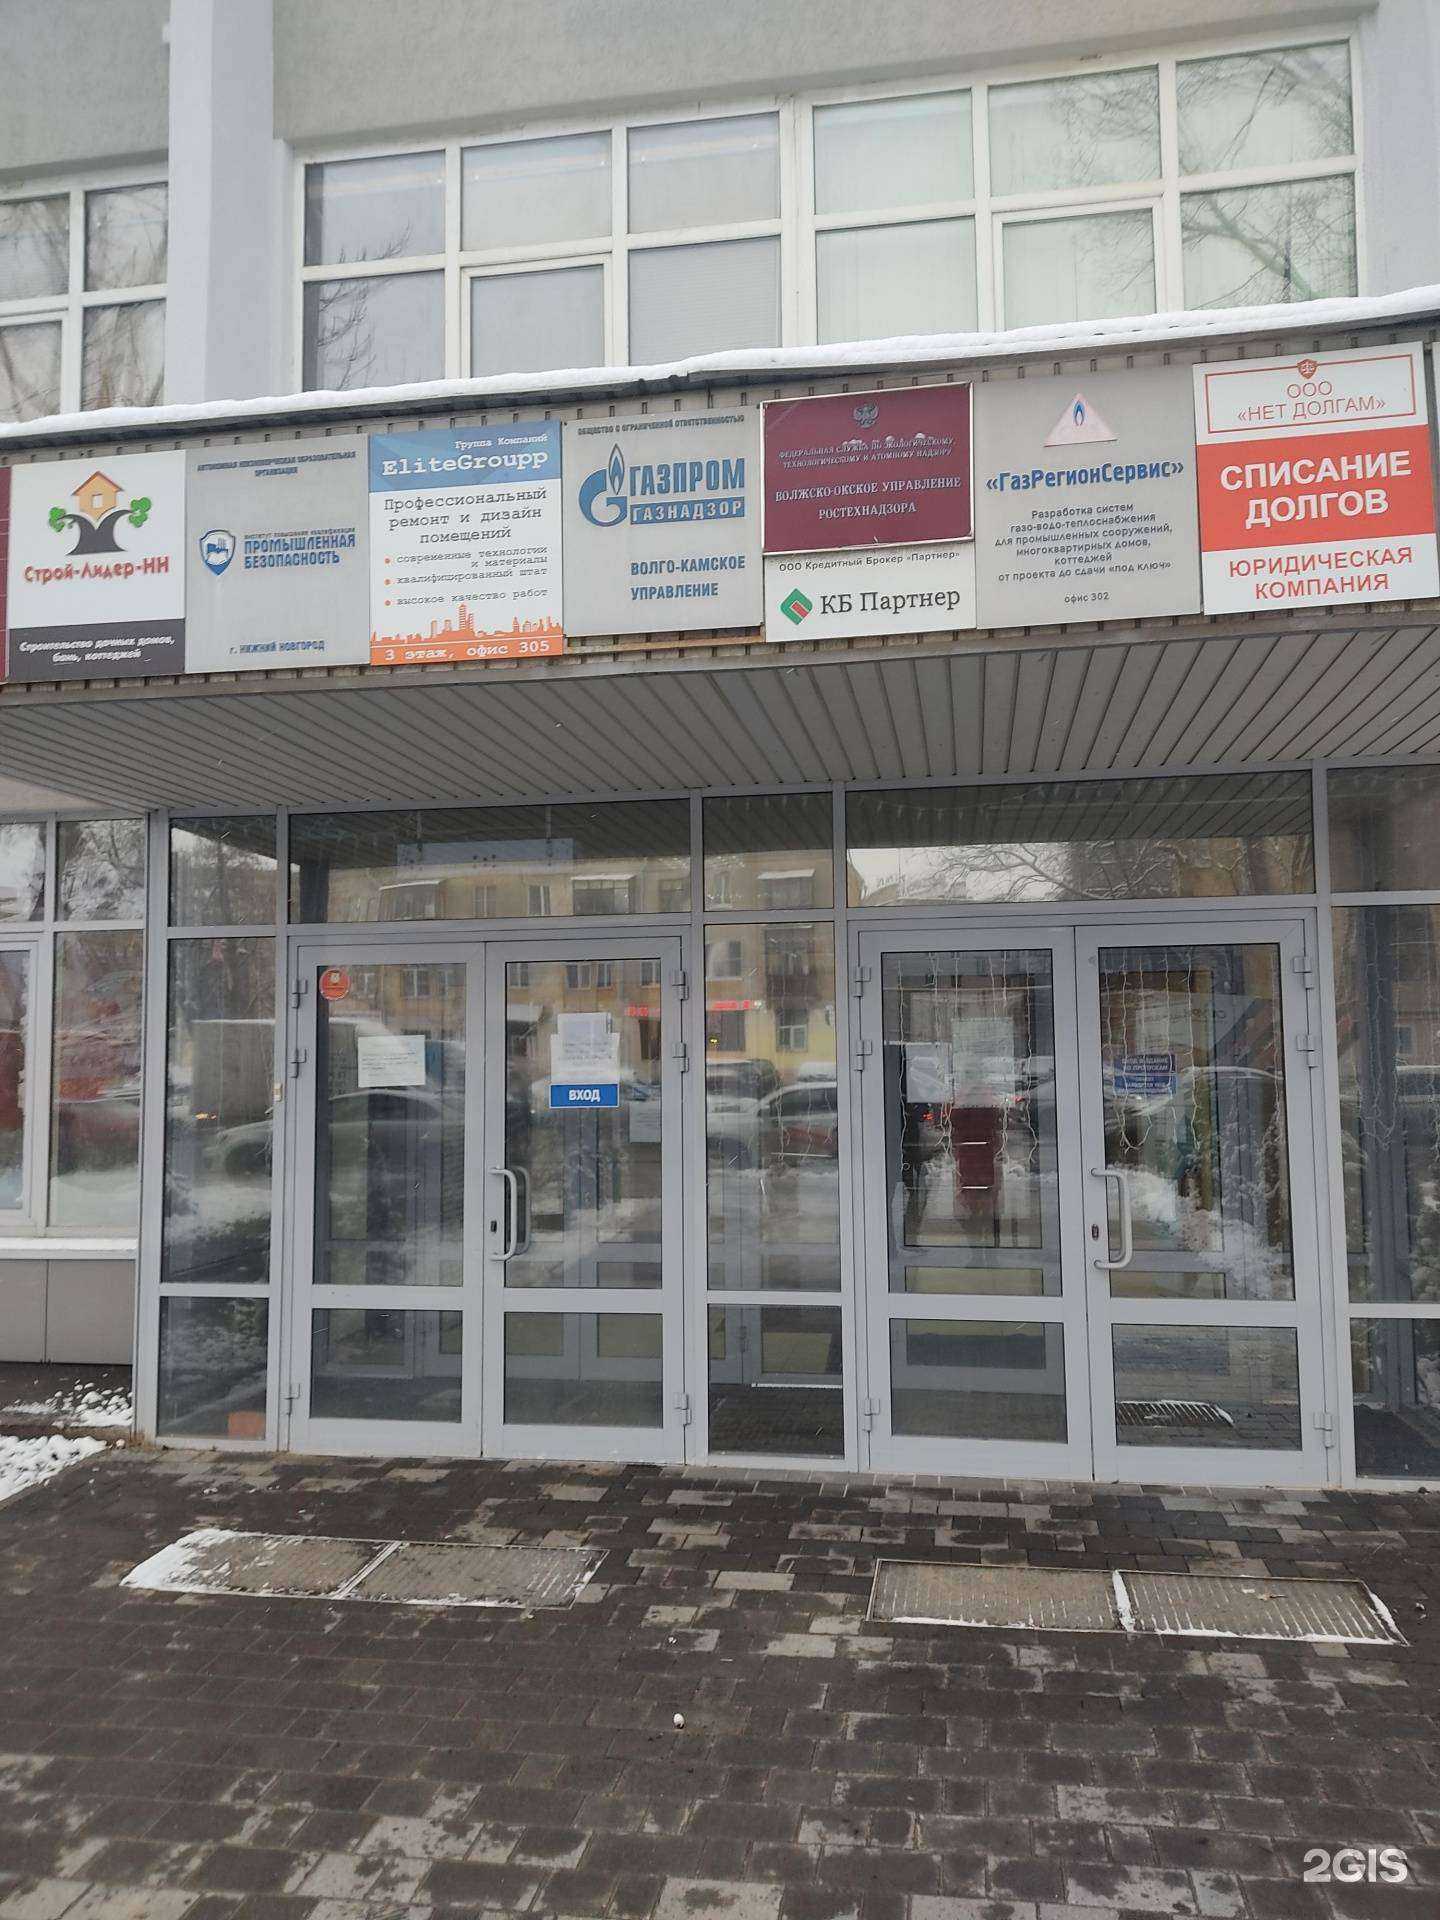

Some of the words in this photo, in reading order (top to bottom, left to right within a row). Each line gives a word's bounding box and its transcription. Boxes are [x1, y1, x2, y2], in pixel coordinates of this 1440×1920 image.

[1286, 381, 1333, 399] ООО
[1237, 403, 1287, 421] «НЕТ
[1293, 396, 1386, 420] ДОЛГАМ»
[455, 438, 492, 450] Группа
[497, 433, 548, 446] Компаний
[778, 446, 834, 460] ФЕДЕРАЛЬНАЯ
[382, 451, 548, 476] EliteGroupp
[1220, 450, 1412, 491] СПИСАНИЕ
[629, 458, 745, 496] ГАЗПРОМ
[986, 461, 1184, 491] «ГазРегионСервис»
[775, 482, 878, 501] ВОЛЖСКО-ОКСКОЕ
[882, 476, 961, 492] УПРАВЛЕНИЕ
[384, 487, 547, 512] Профессиональный
[1245, 489, 1389, 529] ДОЛГОВ
[389, 514, 449, 530] ремонт
[460, 514, 470, 523] и
[480, 507, 542, 524] дизайн
[632, 500, 742, 522] ГАЗНАДЗОР
[819, 501, 917, 519] РОСТЕХНАДЗОРА
[1031, 506, 1093, 520] Разработка
[1096, 503, 1134, 514] систем
[1010, 513, 1156, 533] газо-водо-теплоснабжения
[244, 534, 355, 554] ПРОМЫШЛЕННАЯ
[420, 527, 511, 544] помещений
[995, 538, 1013, 548] для
[1016, 531, 1099, 547] промышленных
[1102, 523, 1173, 538] сооружений,
[396, 552, 472, 565] современные
[478, 545, 547, 558] технологии
[1016, 542, 1112, 557] многоквартирных
[1115, 538, 1151, 551] домов,
[244, 551, 340, 569] БЕЗОПАСНОСТЬ
[471, 560, 478, 568] и
[485, 557, 547, 568] материалы
[631, 556, 746, 576] ВОЛГО-КАМСКОЕ
[779, 562, 802, 572] ООО
[805, 557, 863, 571] Кредитный
[866, 555, 903, 568] Брокер
[907, 551, 960, 564] «Партнер»
[1054, 553, 1112, 566] коттеджей
[1229, 547, 1412, 578] ЮРИДИЧЕСКАЯ
[24, 556, 170, 584] Строй-Лидер-НН
[520, 567, 547, 576] штат
[998, 574, 1010, 582] от
[1013, 569, 1056, 582] проекта
[1058, 568, 1071, 578] до
[1075, 566, 1105, 577] сдачи
[397, 595, 444, 605] высокое
[451, 592, 506, 602] качество
[513, 588, 548, 600] работ
[631, 582, 719, 600] УПРАВЛЕНИЕ
[1255, 573, 1389, 600] КОМПАНИЯ
[820, 594, 852, 614] КБ
[860, 590, 960, 614] Партнер
[1064, 594, 1088, 604] офис
[1091, 592, 1109, 601] 302
[19, 639, 93, 653] Строительство
[85, 649, 142, 661] коттеджей
[385, 649, 395, 660] 3
[404, 649, 454, 660] этаж,
[466, 643, 509, 658] офис
[519, 640, 549, 653] 305
[568, 1089, 600, 1102] ВХОД
